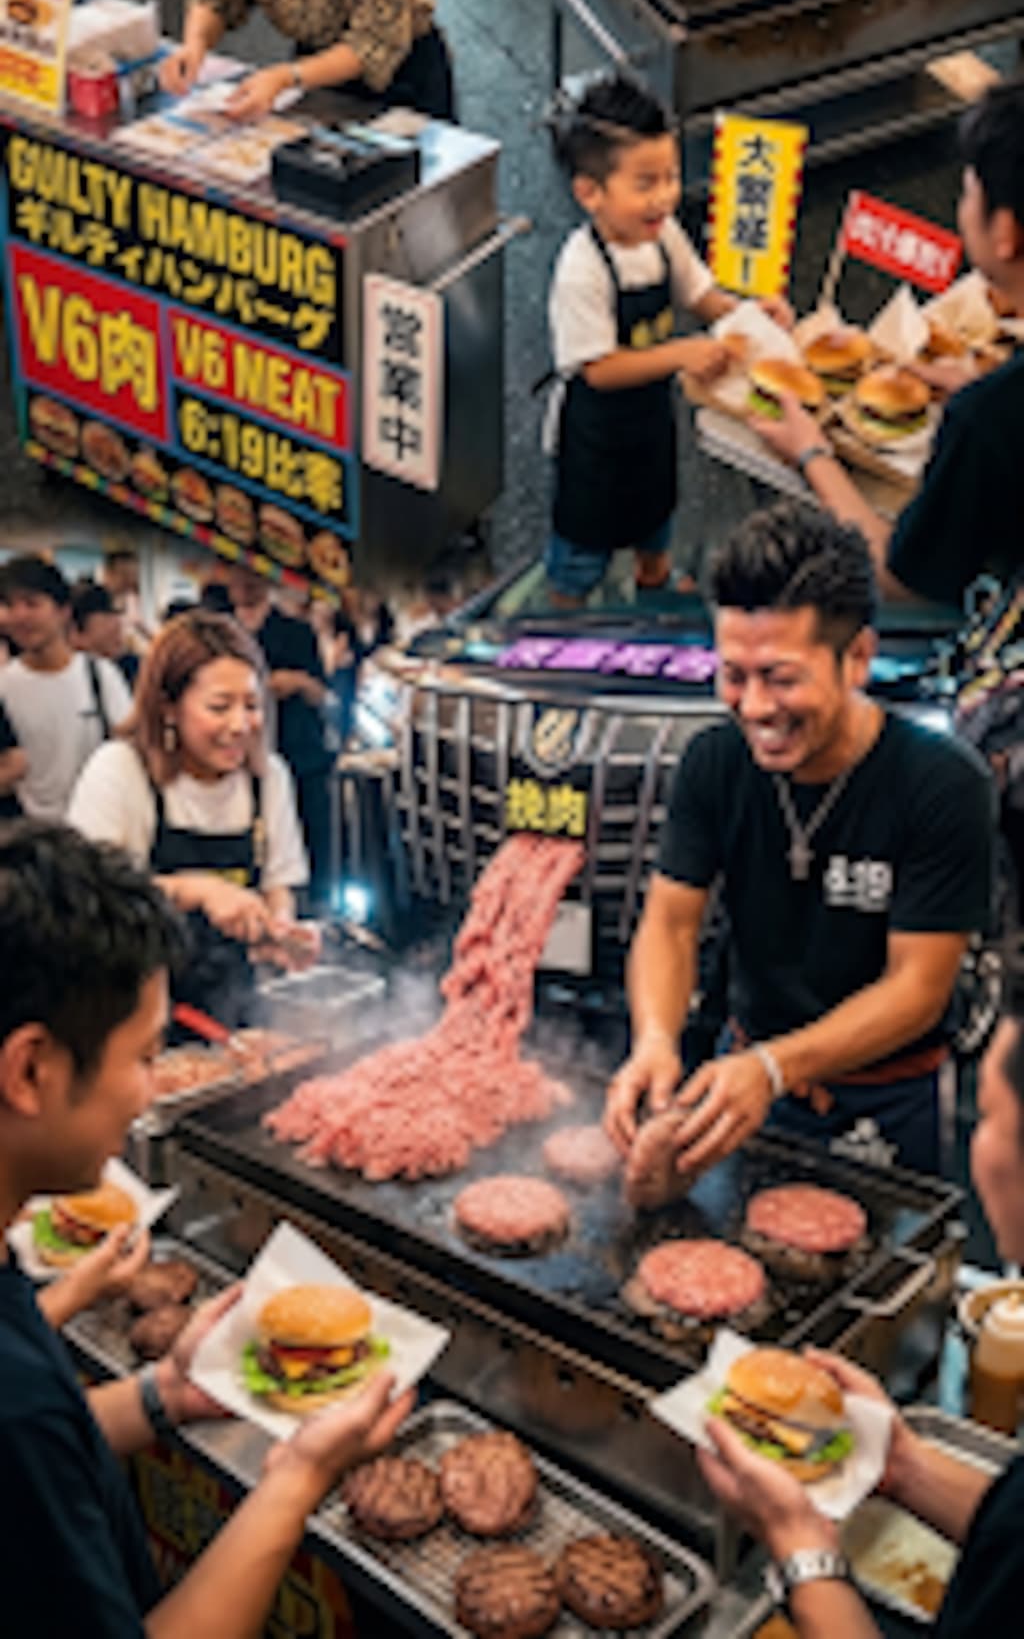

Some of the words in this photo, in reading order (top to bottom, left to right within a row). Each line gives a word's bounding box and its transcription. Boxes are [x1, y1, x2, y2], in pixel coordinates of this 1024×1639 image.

[7, 137, 133, 228] GUILTY
[138, 183, 337, 308] HAMBURG
[16, 196, 335, 350] ギルティハンバーグ
[18, 272, 160, 414] V6肉
[174, 318, 227, 388] V6
[380, 304, 424, 462] 営業中
[505, 777, 587, 838] 挽肉
